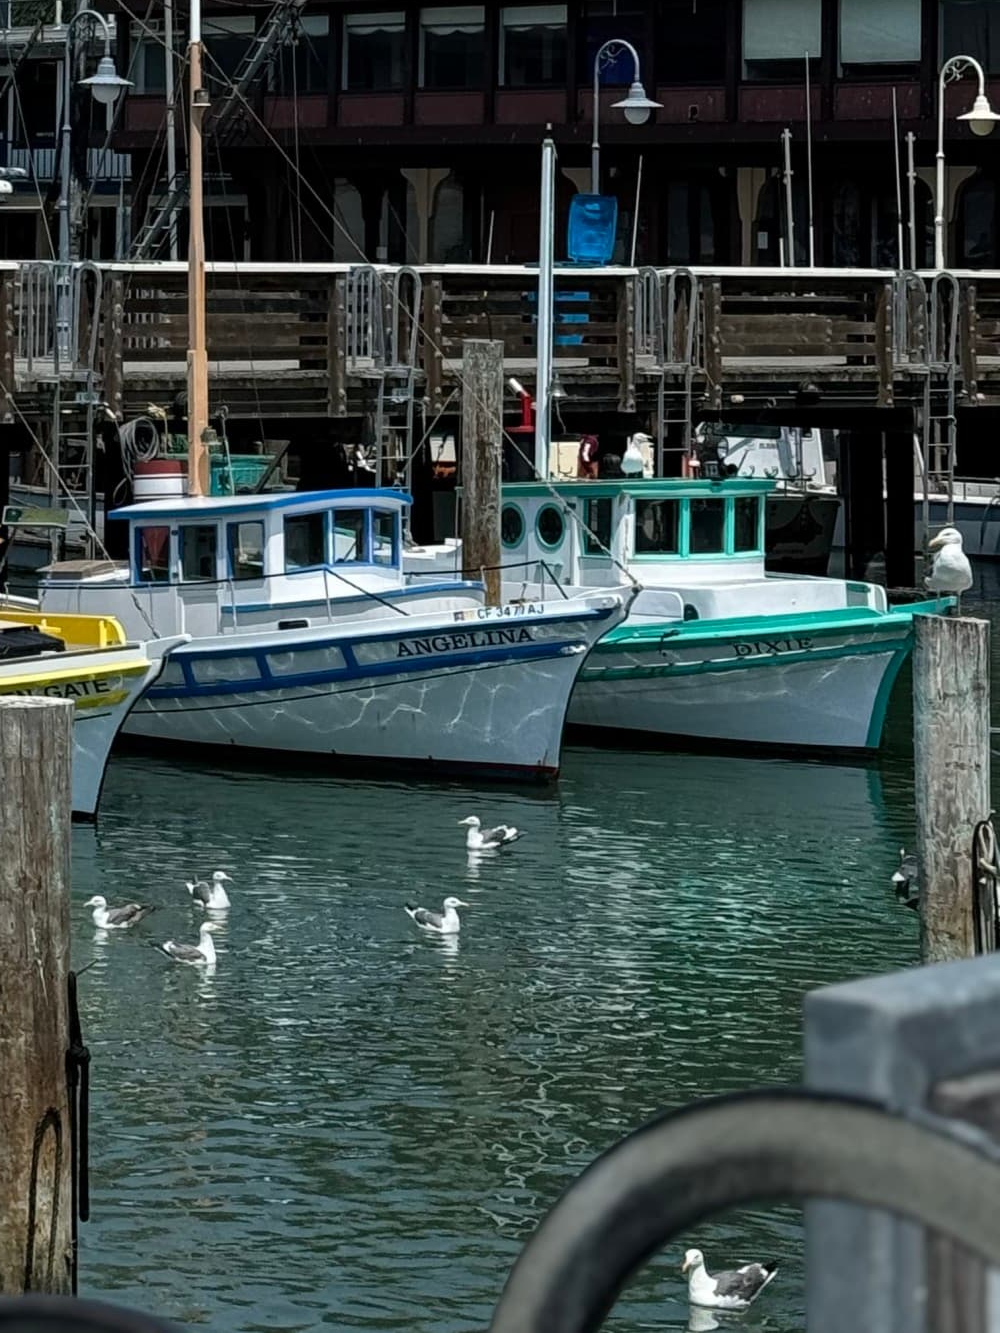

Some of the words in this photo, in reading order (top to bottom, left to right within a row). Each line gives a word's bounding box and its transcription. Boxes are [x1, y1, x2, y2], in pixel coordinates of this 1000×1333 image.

[477, 607, 492, 620] CF
[528, 603, 545, 615] AJ
[396, 628, 536, 657] ANGELINA
[733, 637, 813, 657] DIXIE
[44, 678, 110, 700] GATE
